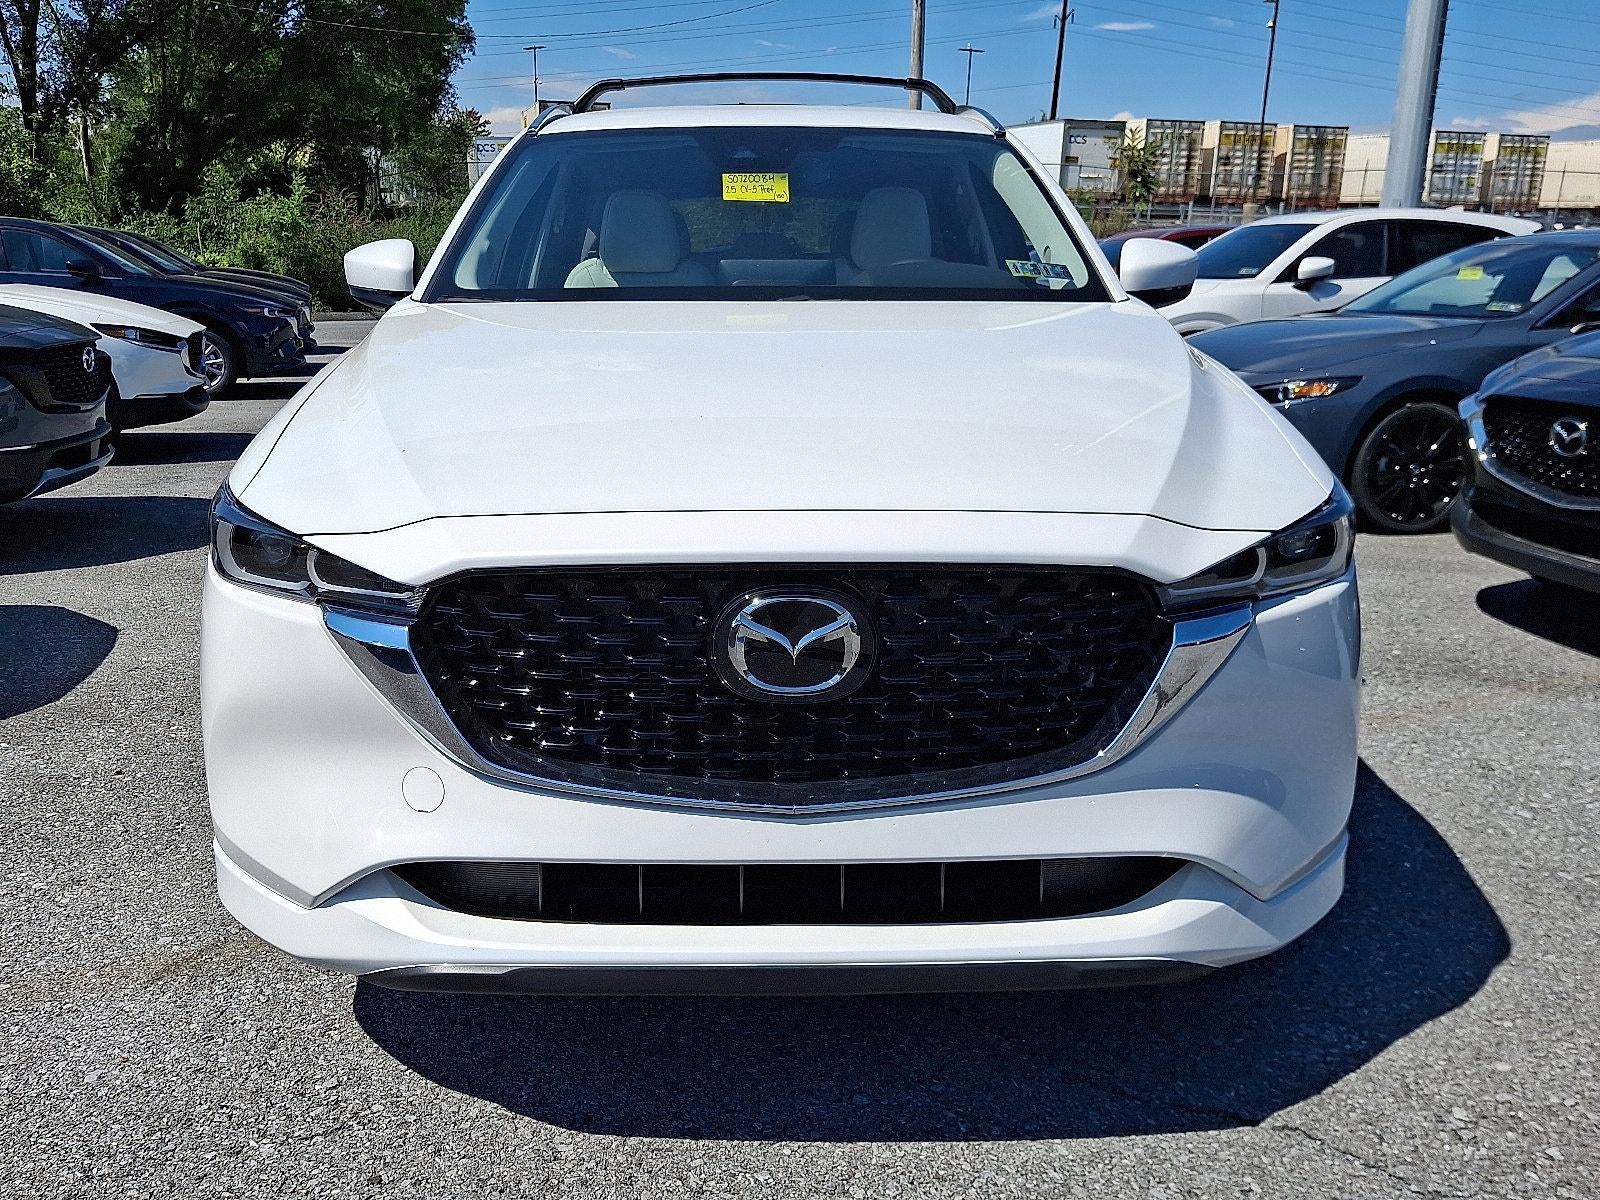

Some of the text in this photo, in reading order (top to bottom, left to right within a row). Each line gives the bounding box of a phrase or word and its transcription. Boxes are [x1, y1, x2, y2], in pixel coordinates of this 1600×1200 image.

[1069, 134, 1087, 144] DCS
[477, 143, 495, 152] DCS
[725, 185, 737, 193] 25
